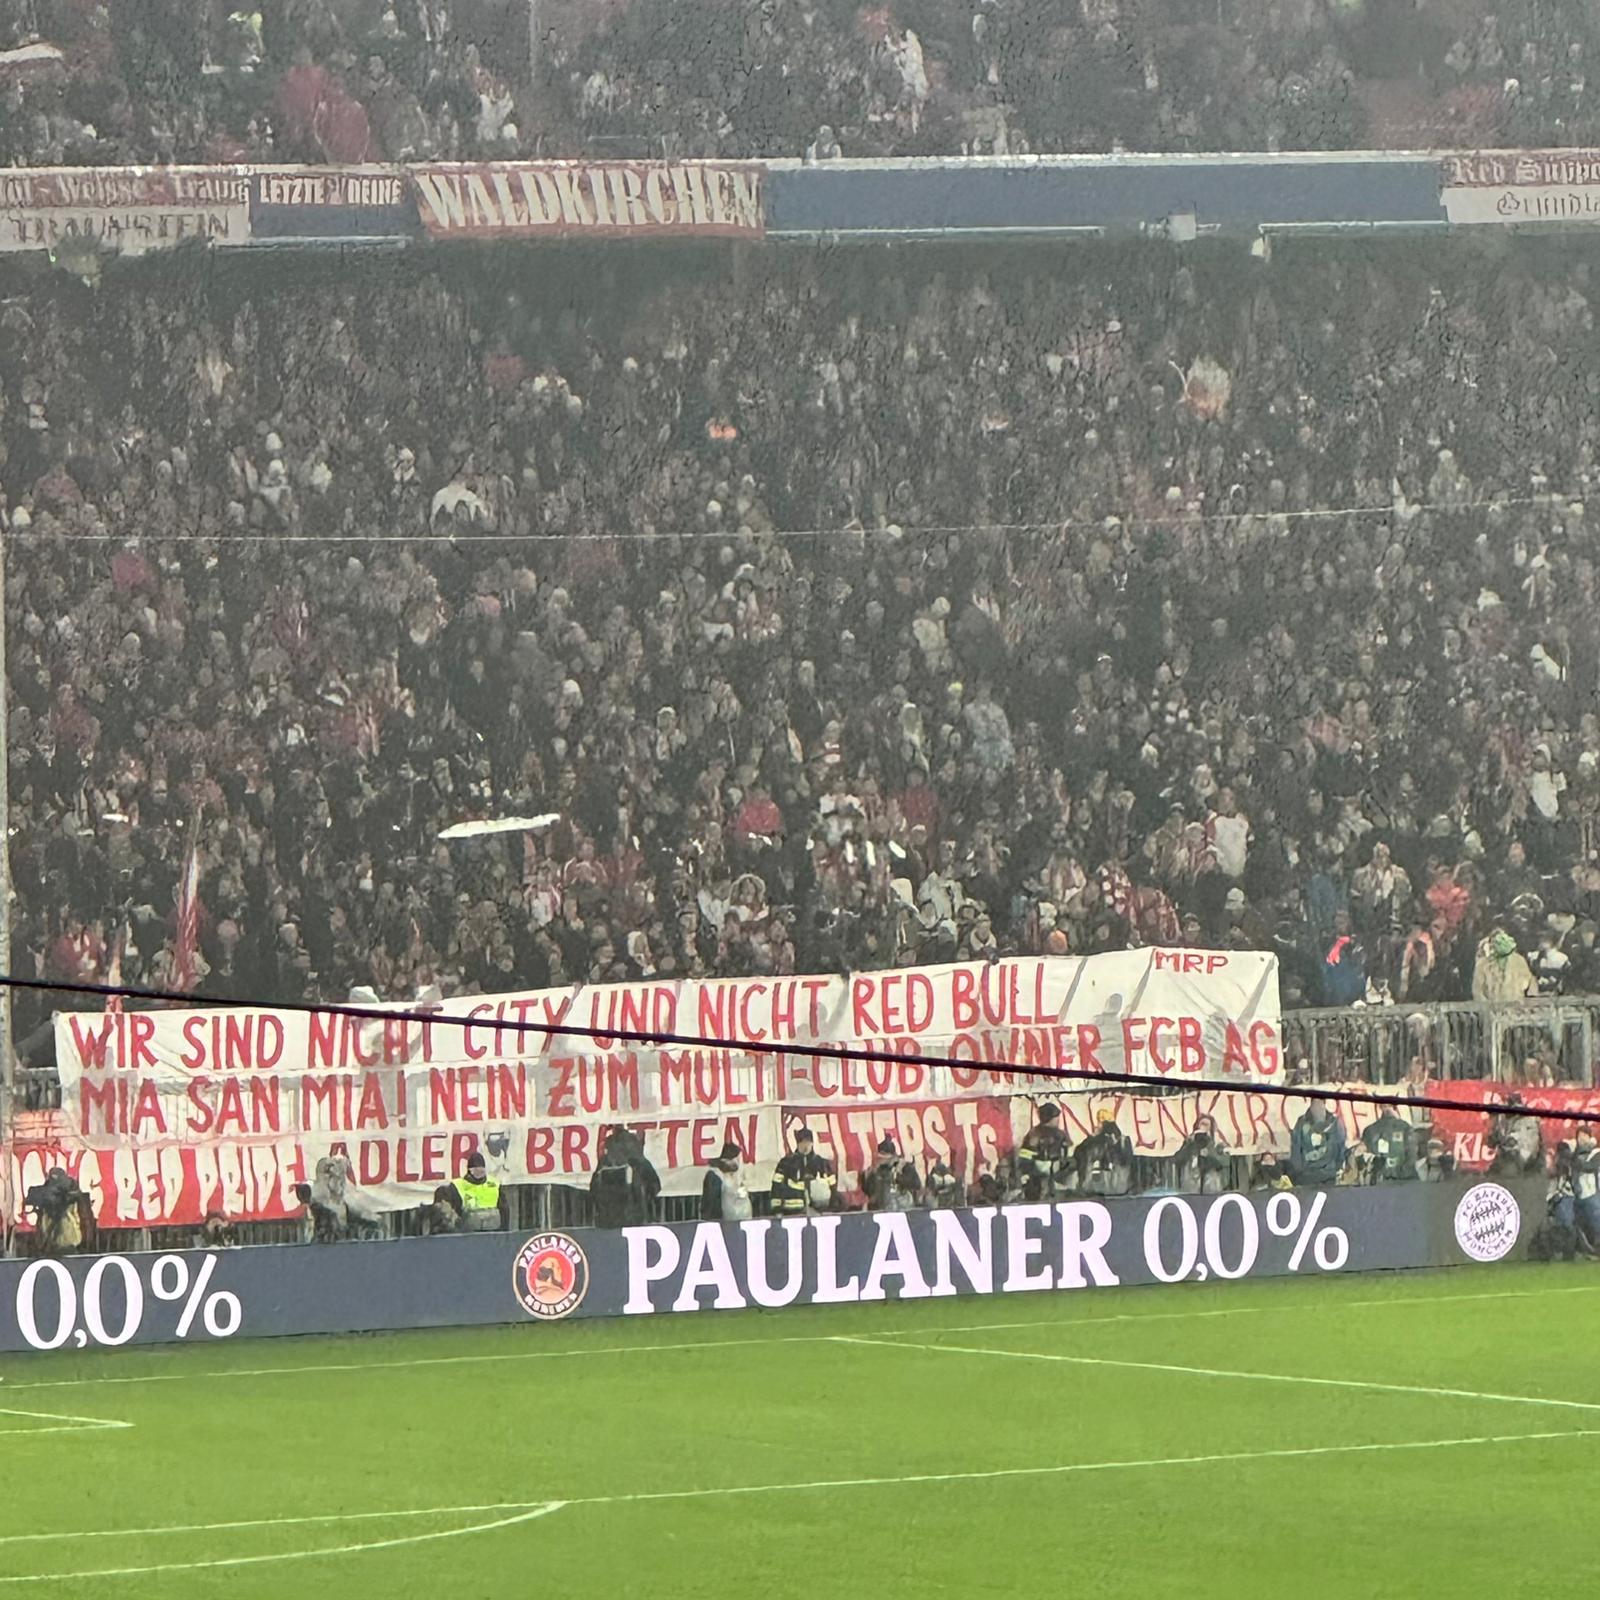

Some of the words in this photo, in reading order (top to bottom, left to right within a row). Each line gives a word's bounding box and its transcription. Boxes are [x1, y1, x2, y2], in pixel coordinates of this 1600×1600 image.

[414, 166, 762, 229] WALDKIRCHEN
[1155, 951, 1228, 974] MRP
[69, 1013, 159, 1069] WIR
[181, 1014, 284, 1069] SIND
[307, 1002, 443, 1068] NICHT
[464, 995, 570, 1059] CITY
[591, 988, 677, 1050] UND
[699, 981, 829, 1043] NICHT
[853, 974, 934, 1036] RED
[952, 963, 1059, 1029] BULL
[80, 1075, 168, 1136] MIA
[186, 1074, 280, 1134] SAN
[302, 1069, 407, 1132] MIA!
[430, 1061, 527, 1125] NEIN
[547, 1052, 640, 1117] ZUM
[659, 1036, 923, 1106] MULTI-CLUB
[950, 1024, 1105, 1088] OWNER
[1122, 1017, 1206, 1074] FCB
[1222, 1019, 1279, 1075] AG
[115, 1143, 184, 1222] RED
[196, 1139, 307, 1218] PRIDE
[16, 1253, 242, 1350] 0,0%
[621, 1200, 1120, 1315] PAULANER
[1143, 1191, 1349, 1283] 0,0%
